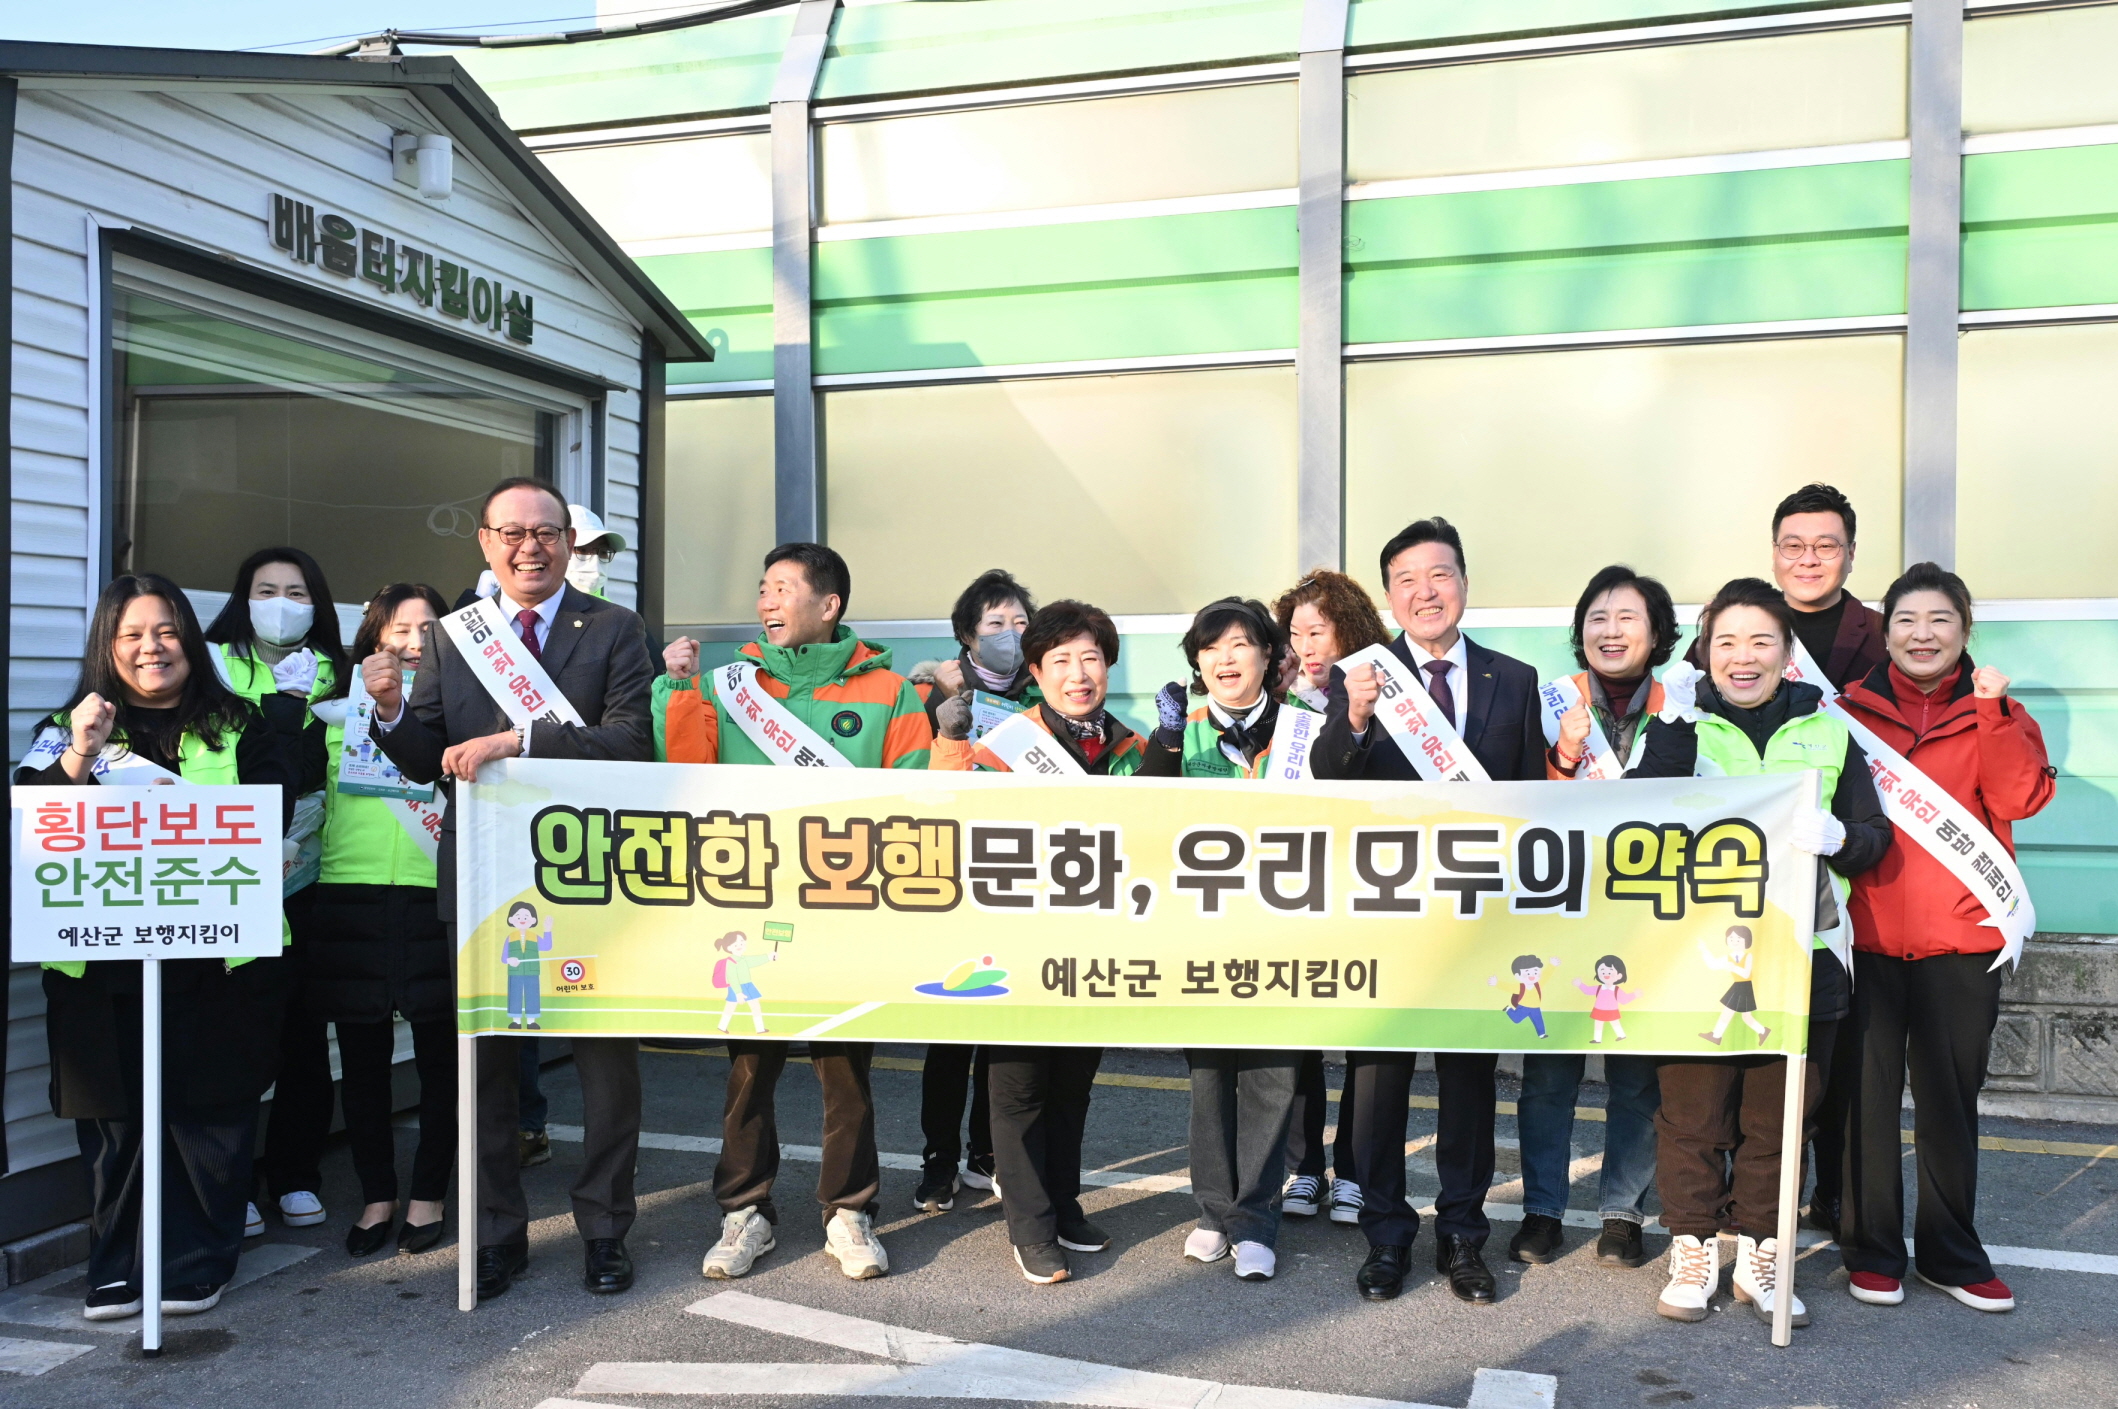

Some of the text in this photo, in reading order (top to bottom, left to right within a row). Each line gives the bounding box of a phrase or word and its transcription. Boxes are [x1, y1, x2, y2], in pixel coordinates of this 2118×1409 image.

[268, 193, 533, 345] 배움터지킴이실
[459, 606, 493, 644] 어린이
[483, 639, 546, 713] 약취·유인
[735, 686, 797, 753] 약취·유인
[1394, 698, 1457, 774] 약취·유인
[1287, 741, 1306, 767] 우리
[34, 800, 262, 852] 횡단보도
[34, 856, 262, 908] 안전준수
[530, 804, 779, 910] 안전한
[1176, 830, 1325, 913] 우리
[1353, 827, 1586, 915] 모두의
[1605, 818, 1769, 920] 약속
[1935, 818, 1976, 856] 예방
[1971, 851, 2013, 903] 캠페인
[57, 923, 241, 948] 예산군 보행지킴이
[556, 983, 595, 993] 어린이 보호
[566, 966, 581, 977] 30
[1041, 956, 1379, 999] 예산군 보행지킴이
